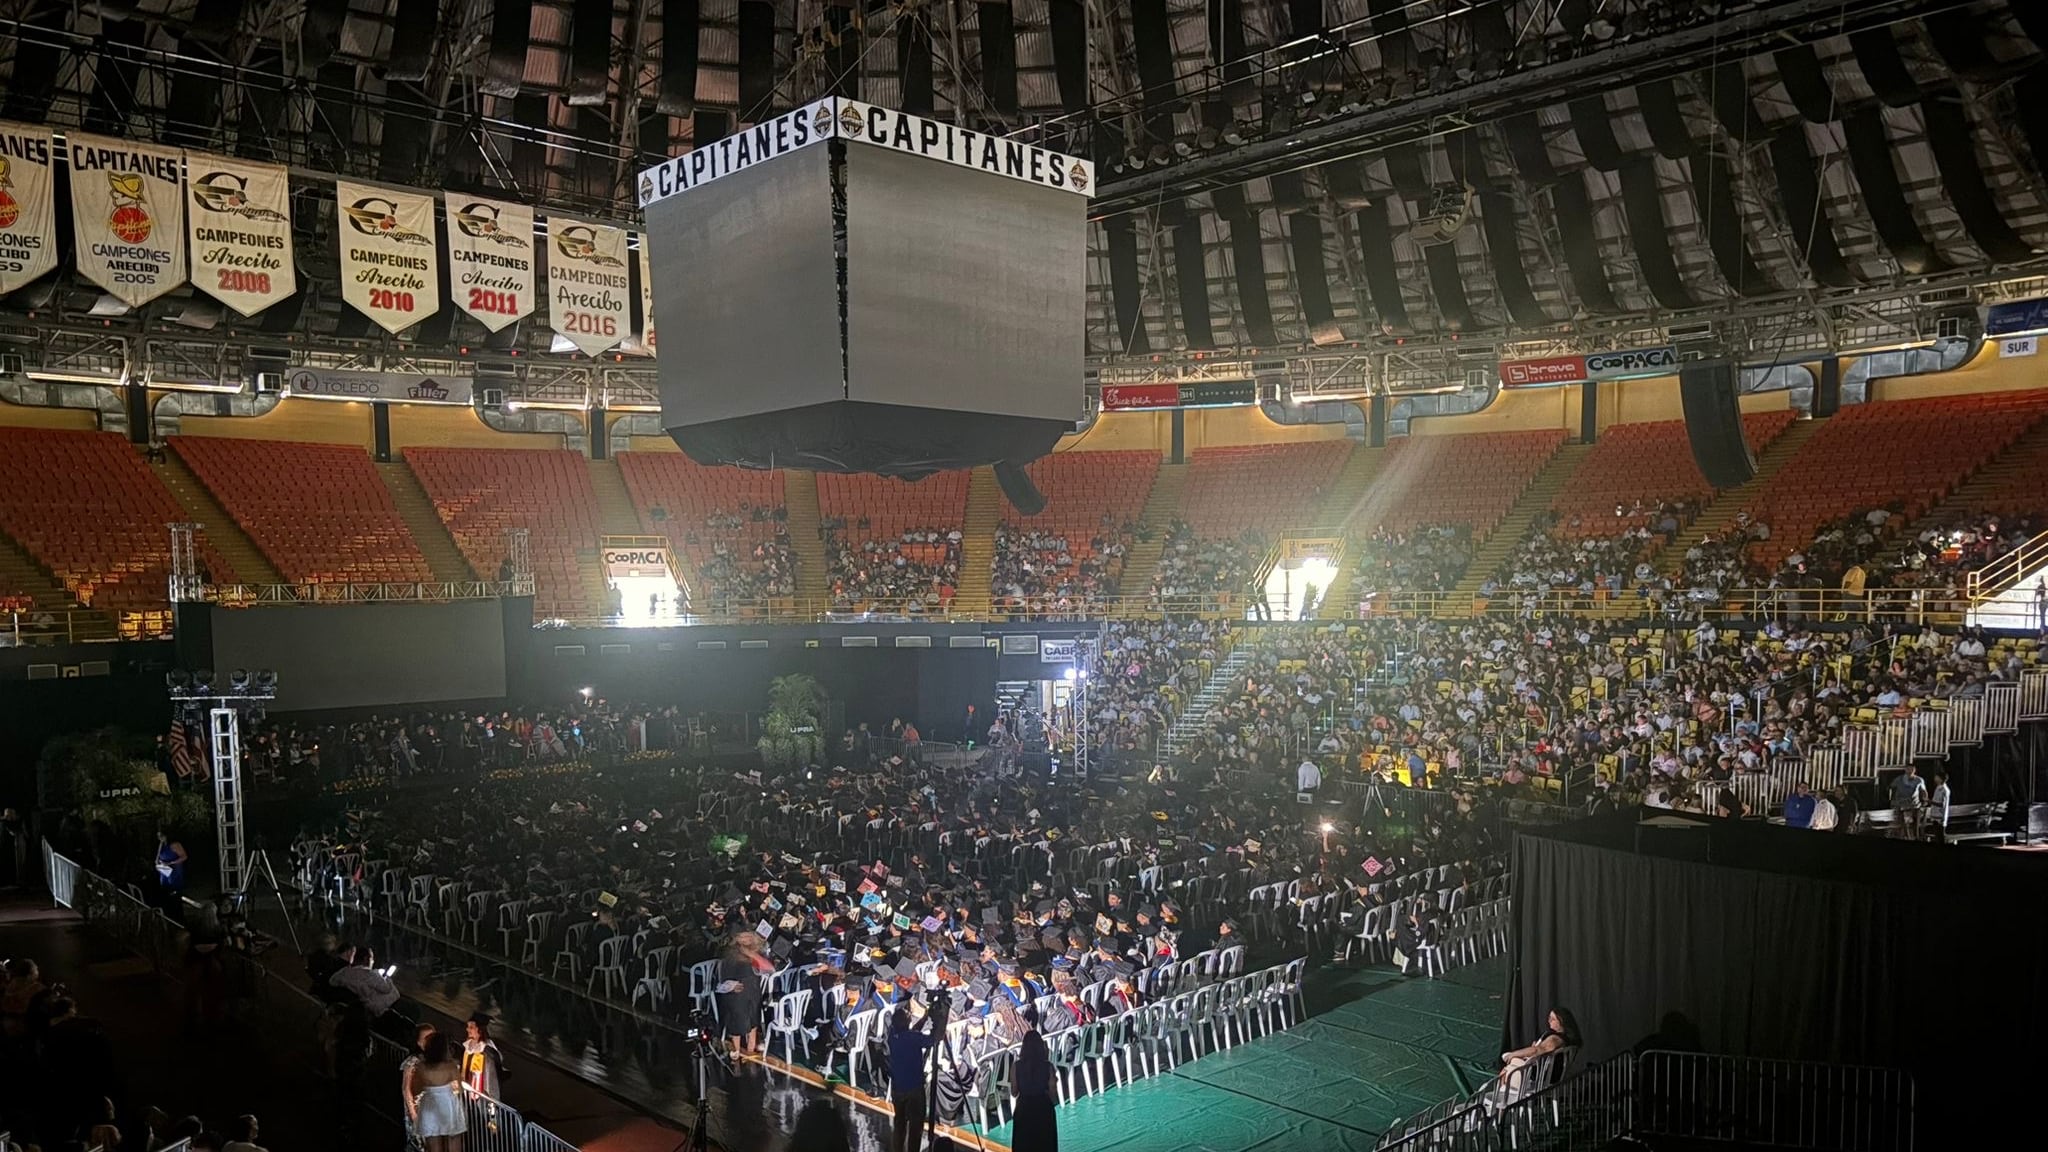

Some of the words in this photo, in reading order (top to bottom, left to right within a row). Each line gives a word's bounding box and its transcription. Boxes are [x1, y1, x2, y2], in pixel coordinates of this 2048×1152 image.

[658, 108, 809, 197] CAPITANES
[867, 106, 1065, 187] CAPITANES
[73, 144, 178, 184] CAPITANES
[196, 227, 284, 249] CAMPEONES
[92, 243, 171, 263] CAMPEONES
[203, 246, 282, 270] Arecibo
[350, 248, 428, 271] CAMPEONES
[453, 249, 529, 271] CAMPEONES
[106, 260, 160, 274] ARECIBO
[114, 272, 156, 285] 2005
[356, 267, 425, 290] Arecibo
[550, 266, 627, 289] CAMPEONES
[217, 268, 271, 294] 2008
[461, 269, 523, 291] Arecibo
[369, 288, 414, 312] 2010
[468, 287, 518, 315] 2011
[557, 285, 622, 312] Arecibo
[563, 311, 616, 337] 2016
[2007, 341, 2029, 353] SUR
[1528, 364, 1575, 375] brava
[322, 381, 380, 394] TOLEDO
[409, 388, 447, 398] Filler
[100, 787, 141, 798] UPRA
